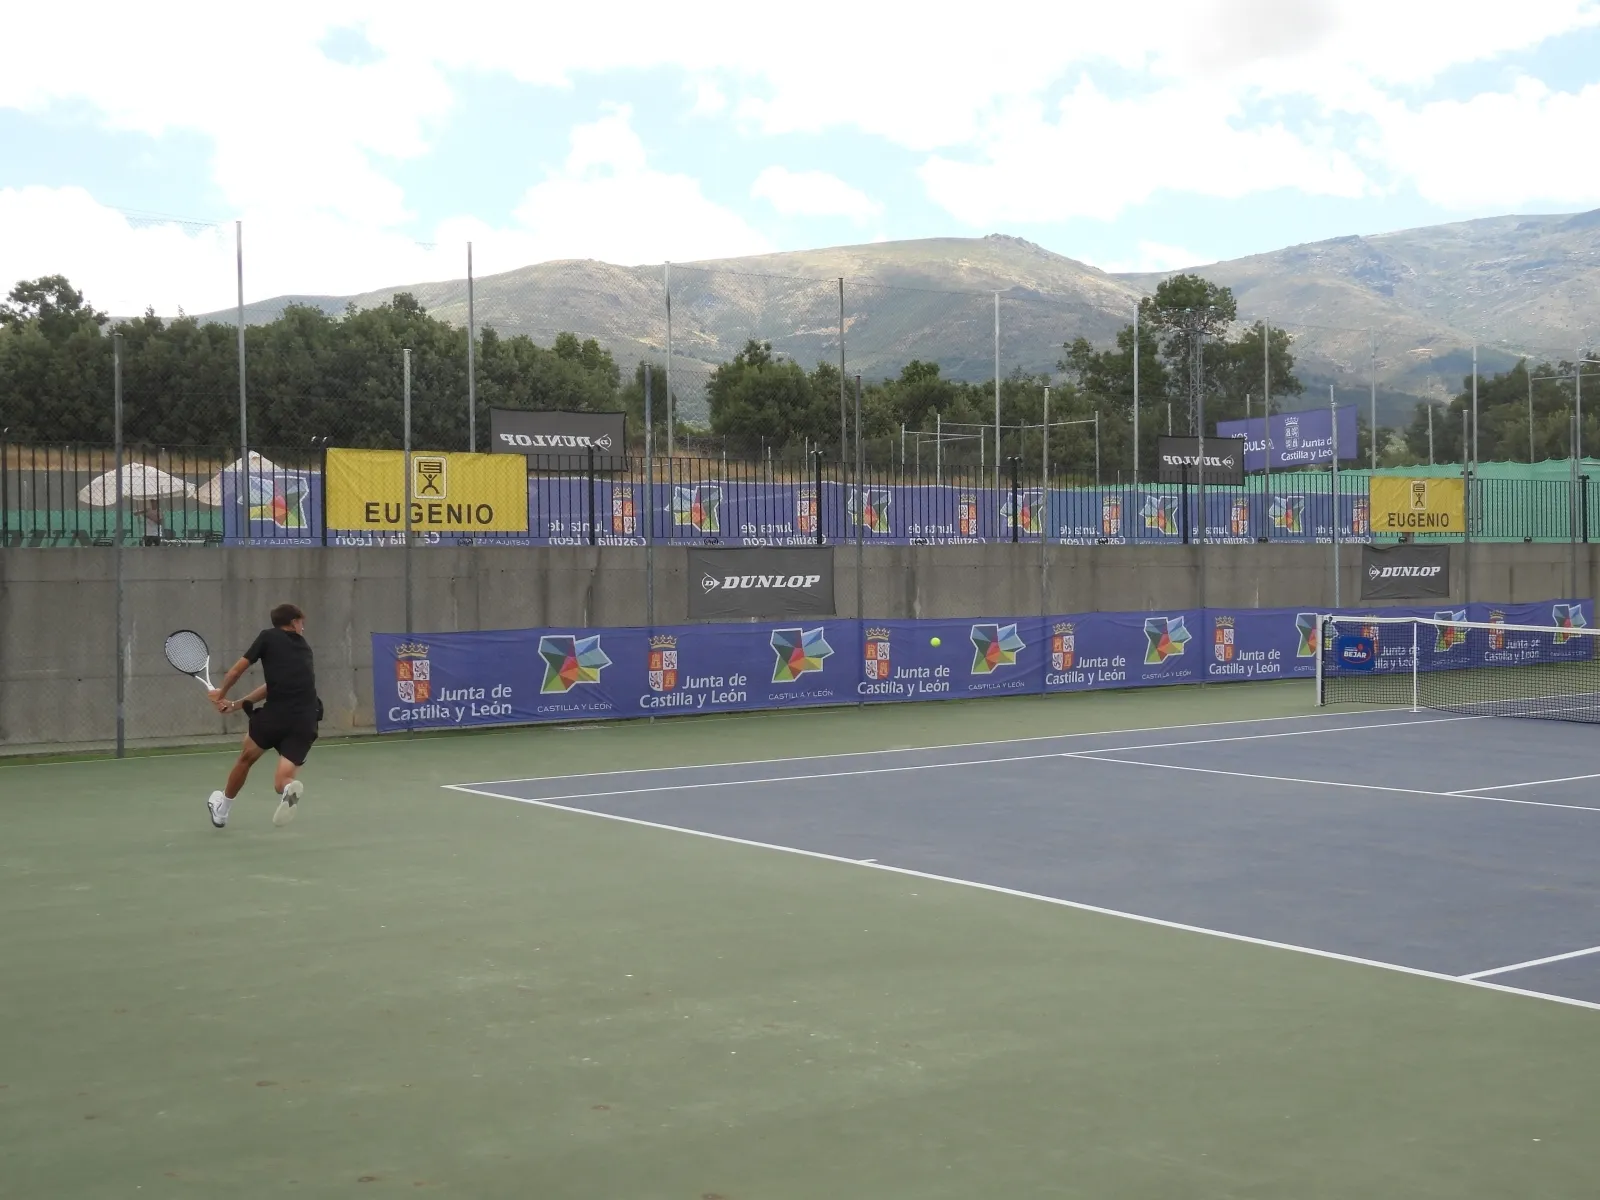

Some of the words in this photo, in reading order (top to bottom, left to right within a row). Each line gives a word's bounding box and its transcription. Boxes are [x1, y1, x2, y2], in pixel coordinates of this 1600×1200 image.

[1301, 439, 1325, 449] Junta
[1326, 437, 1333, 446] d
[1281, 450, 1308, 461] Castilla
[1311, 451, 1316, 460] y
[1319, 448, 1333, 457] Leó
[365, 502, 494, 524] EUGENIO
[1388, 513, 1449, 527] EUGENIO
[1380, 567, 1441, 577] DUNLOP
[721, 575, 820, 589] DUNLOP
[1076, 656, 1108, 669] Junta
[1112, 655, 1126, 667] de
[1237, 650, 1265, 661] Junta
[1268, 649, 1281, 660] de
[894, 666, 930, 679] Junta
[935, 665, 950, 677] de
[1209, 663, 1245, 675] Castilla
[1246, 664, 1254, 677] y
[1256, 662, 1280, 673] León
[682, 675, 724, 690] Junta
[729, 673, 747, 686] de
[1046, 671, 1085, 685] Castilla
[1087, 673, 1095, 685] y
[1098, 669, 1126, 681] León
[437, 686, 485, 702] Junta
[491, 684, 512, 699] de
[857, 681, 904, 695] Castilla
[906, 683, 915, 696] y
[919, 679, 950, 693] León
[640, 693, 692, 708] Castilla
[697, 694, 706, 708] y
[712, 689, 747, 703] León
[388, 704, 450, 721] Castilla
[455, 706, 465, 722] y
[471, 701, 512, 716] León
[537, 704, 579, 713] CASTILLA
